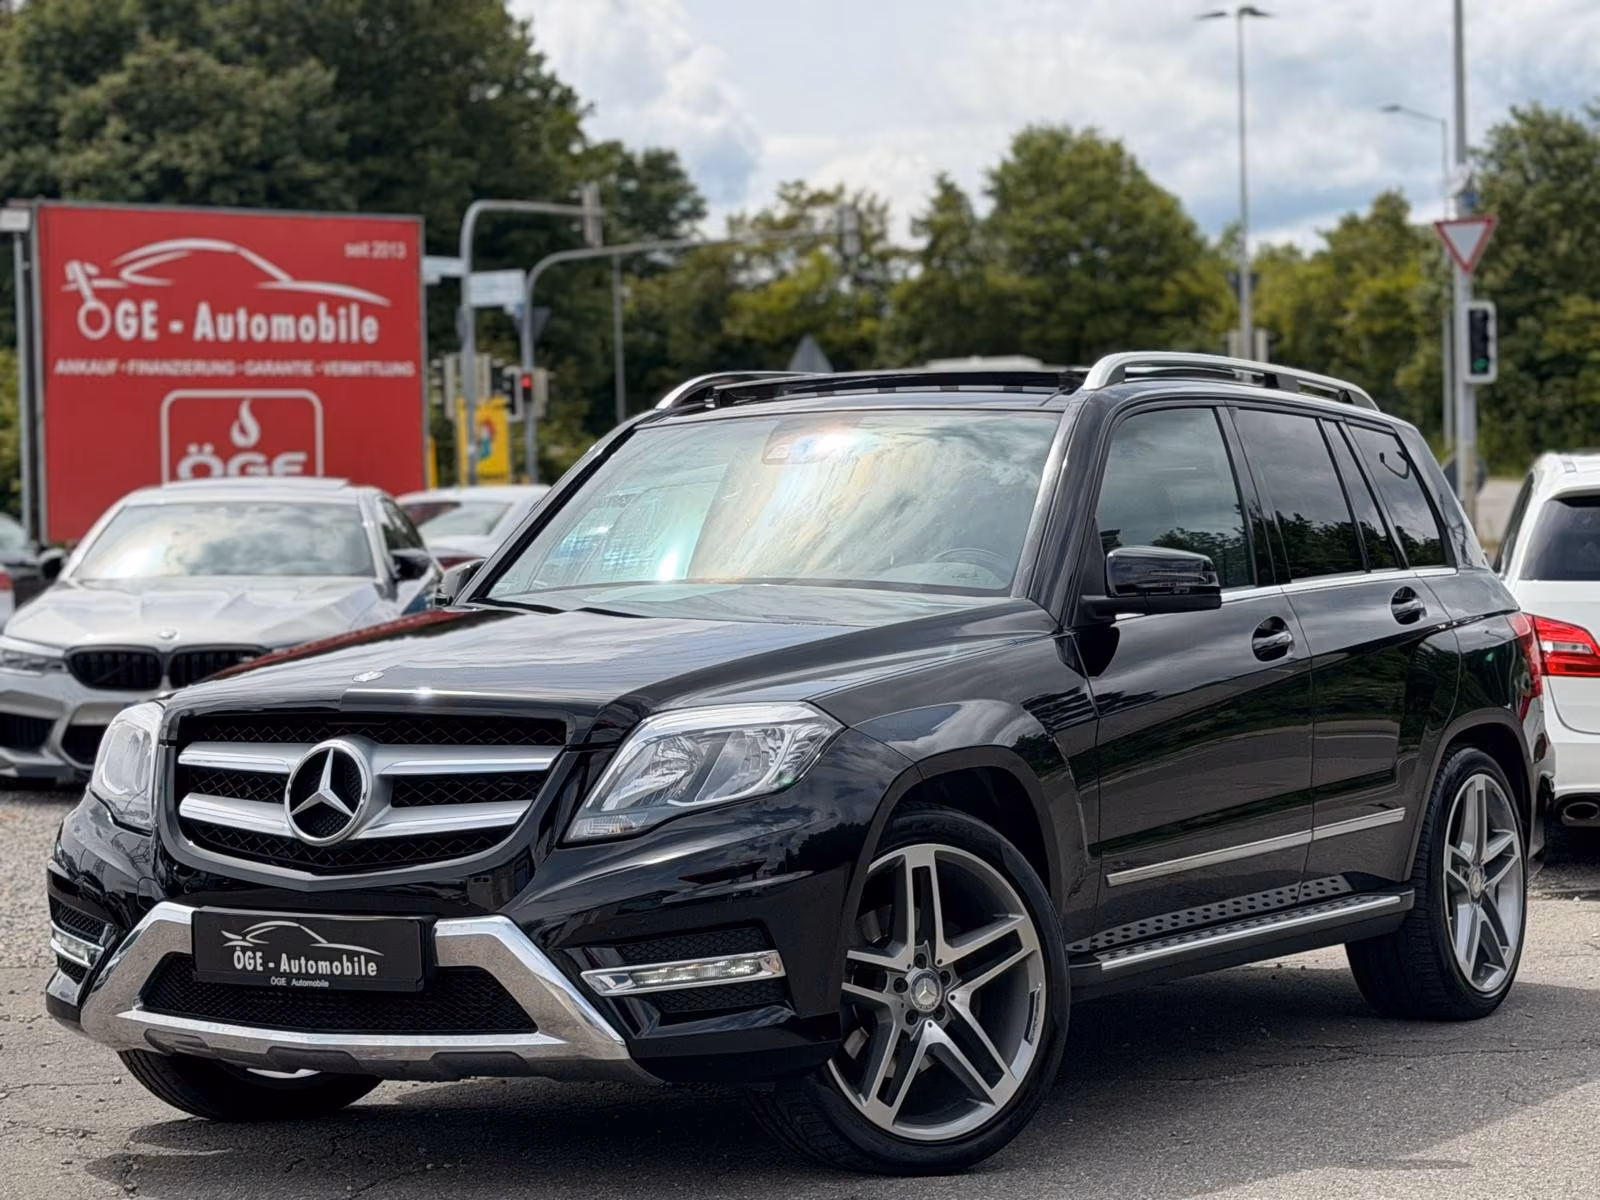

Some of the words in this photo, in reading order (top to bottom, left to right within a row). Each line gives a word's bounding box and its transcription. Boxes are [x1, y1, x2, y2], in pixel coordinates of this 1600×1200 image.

[193, 301, 380, 343] Automobile
[54, 357, 119, 376] ANKAUF
[177, 442, 308, 480] ÖGE
[233, 946, 264, 971] ÖGE
[280, 953, 377, 976] Automobile
[291, 978, 329, 988] Automobile
